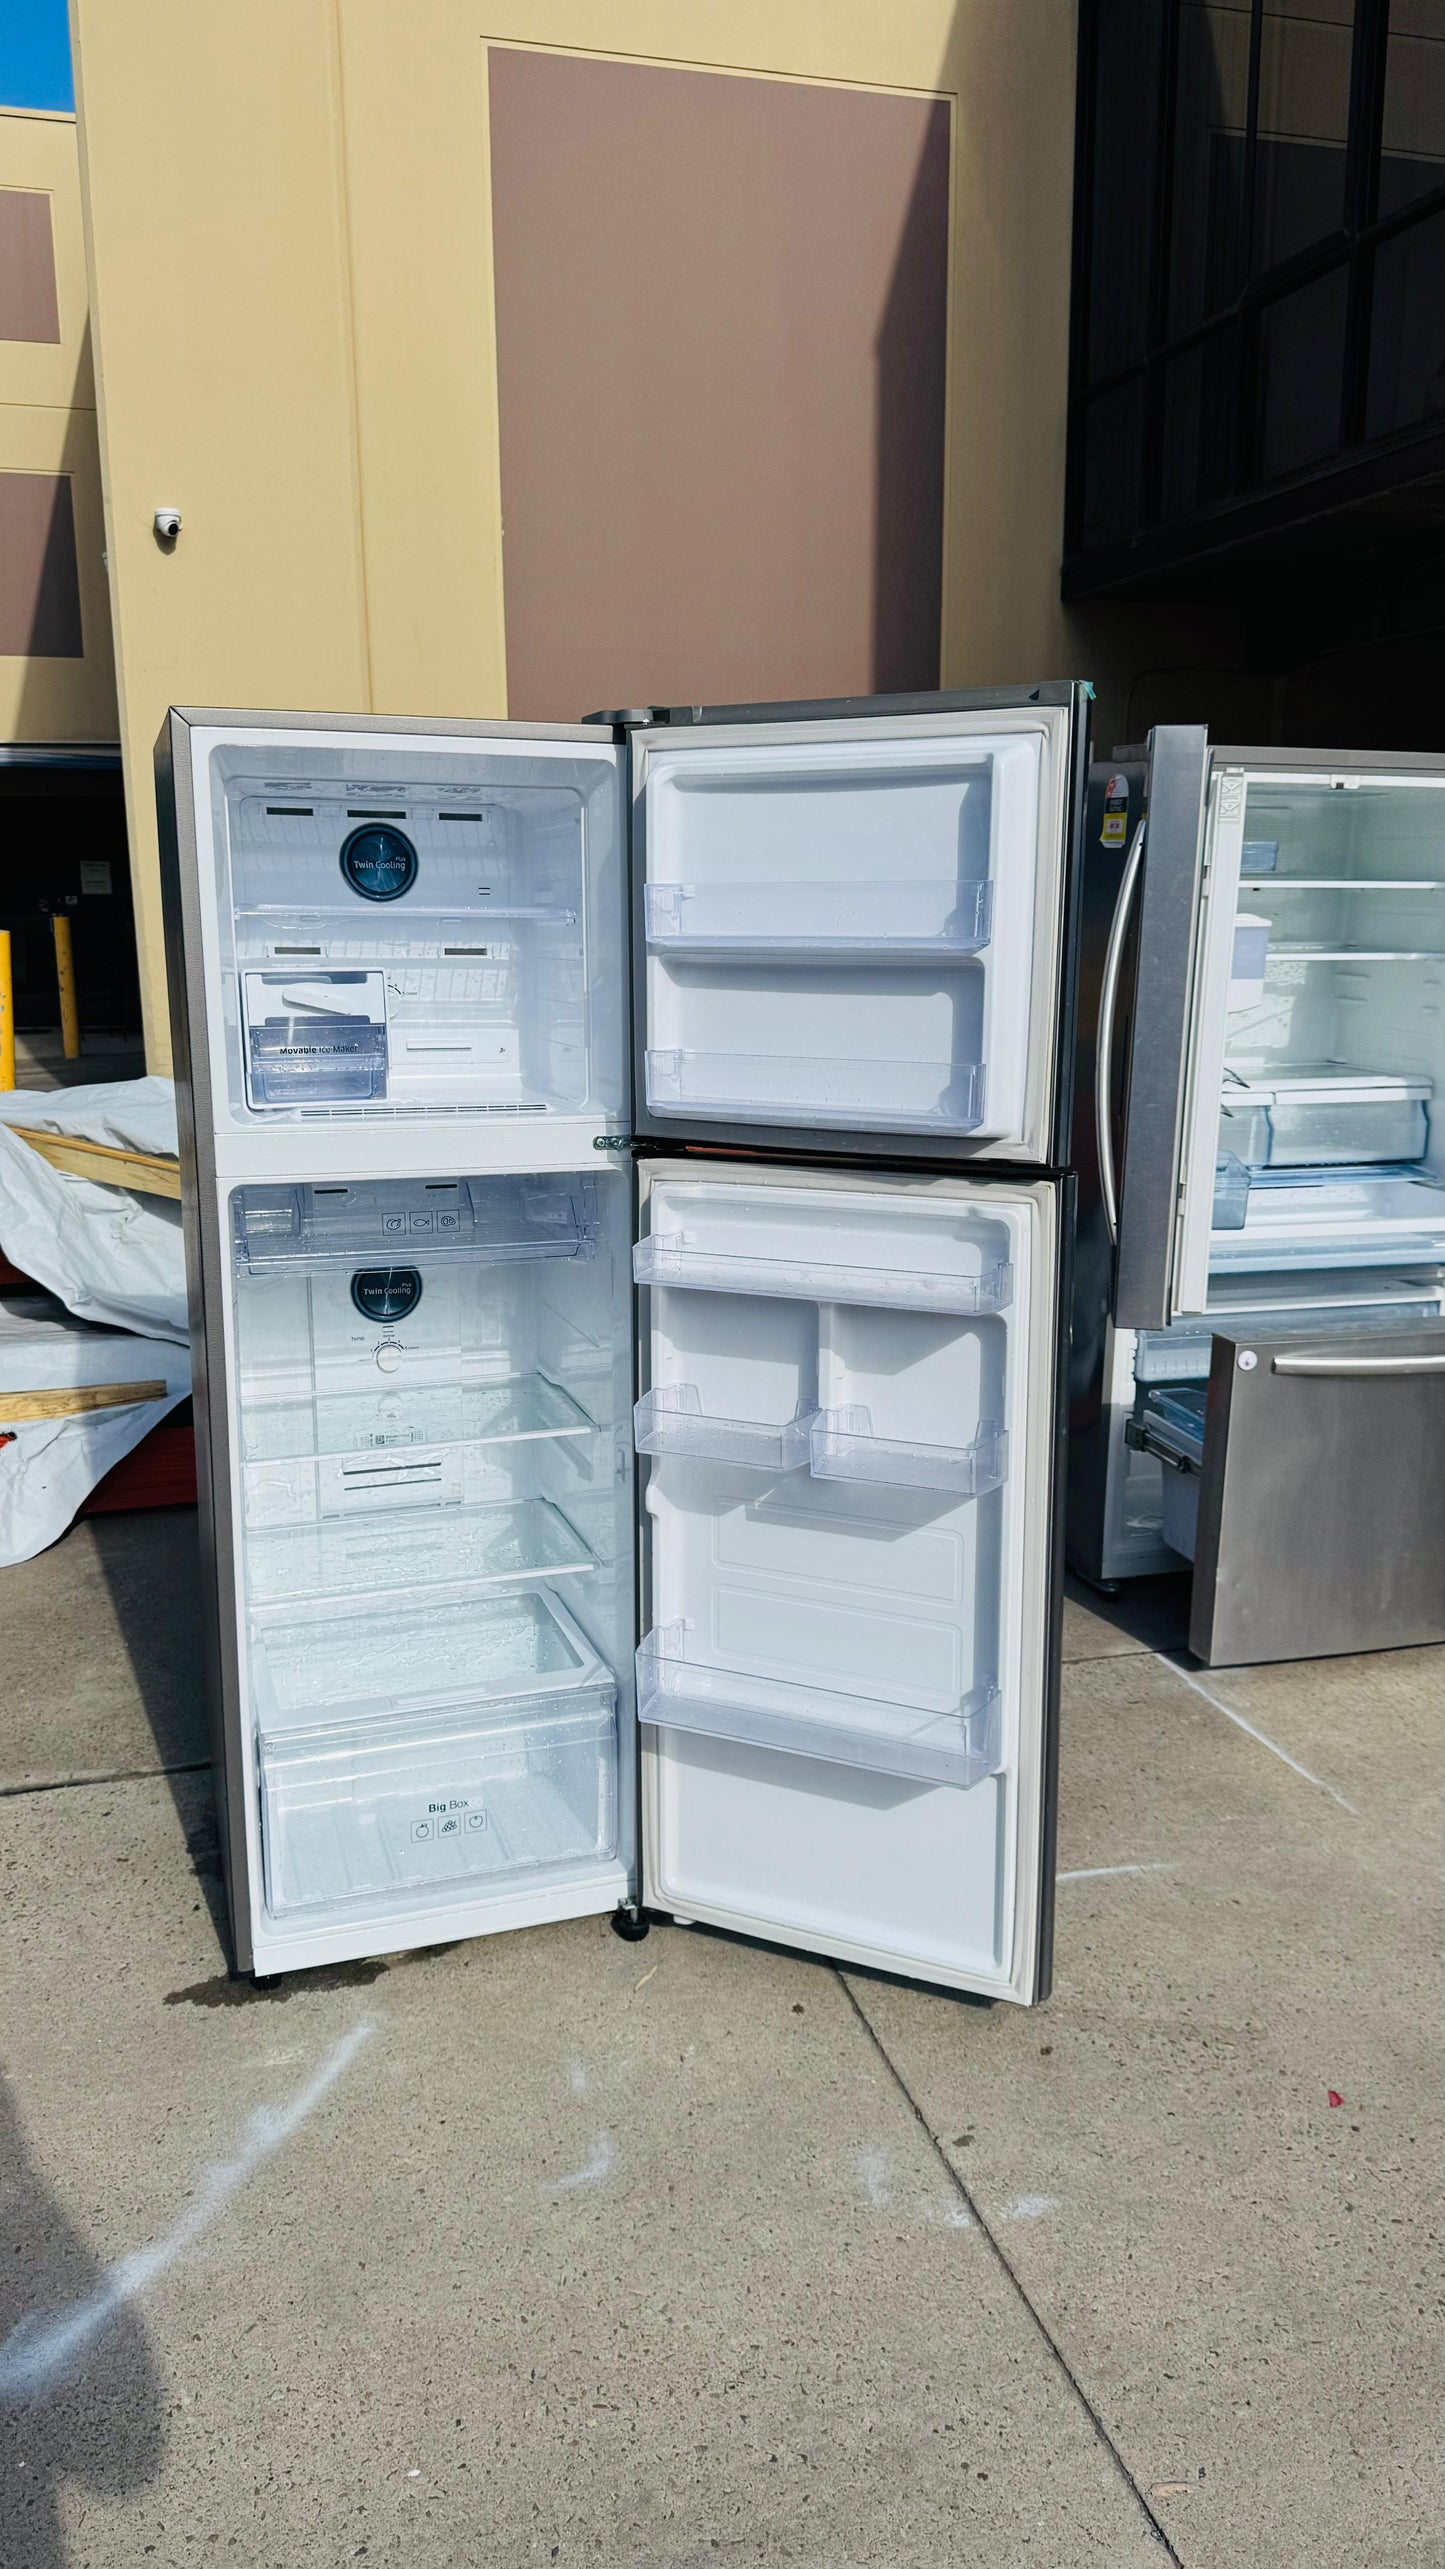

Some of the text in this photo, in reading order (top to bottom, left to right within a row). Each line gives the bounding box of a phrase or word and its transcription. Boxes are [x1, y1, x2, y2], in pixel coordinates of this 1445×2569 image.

[354, 860, 406, 872] Twin Cooling
[280, 1044, 358, 1055] Movable Ice Maker
[364, 1286, 411, 1295] Twin Cooling
[429, 1800, 469, 1813] Big Box
